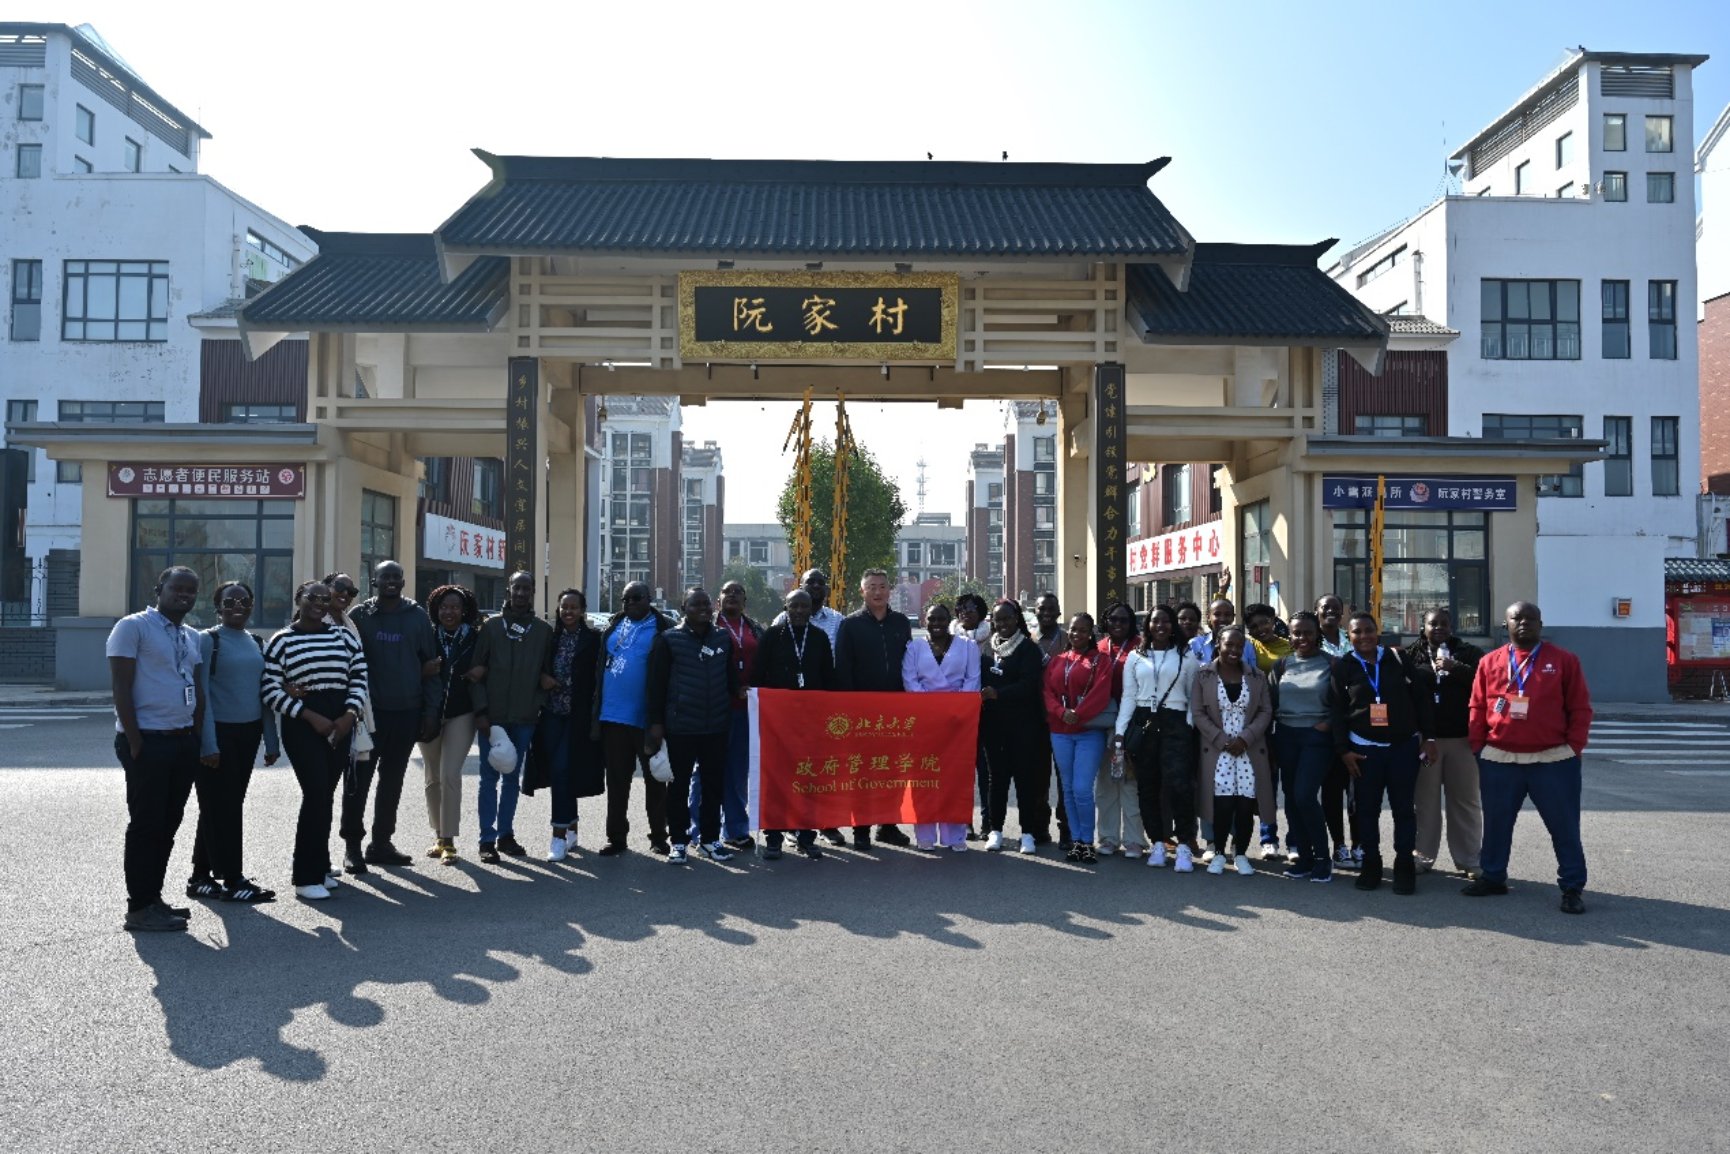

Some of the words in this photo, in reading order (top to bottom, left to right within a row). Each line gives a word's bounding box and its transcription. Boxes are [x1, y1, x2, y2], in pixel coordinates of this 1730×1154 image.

[733, 295, 908, 336] 阮家村
[142, 467, 271, 483] 志愿者便民服务站
[1437, 487, 1506, 501] 阮家村警务室
[795, 753, 941, 777] 政府管理学院
[792, 780, 837, 794] School
[840, 778, 857, 791] of
[858, 777, 940, 790] Government
